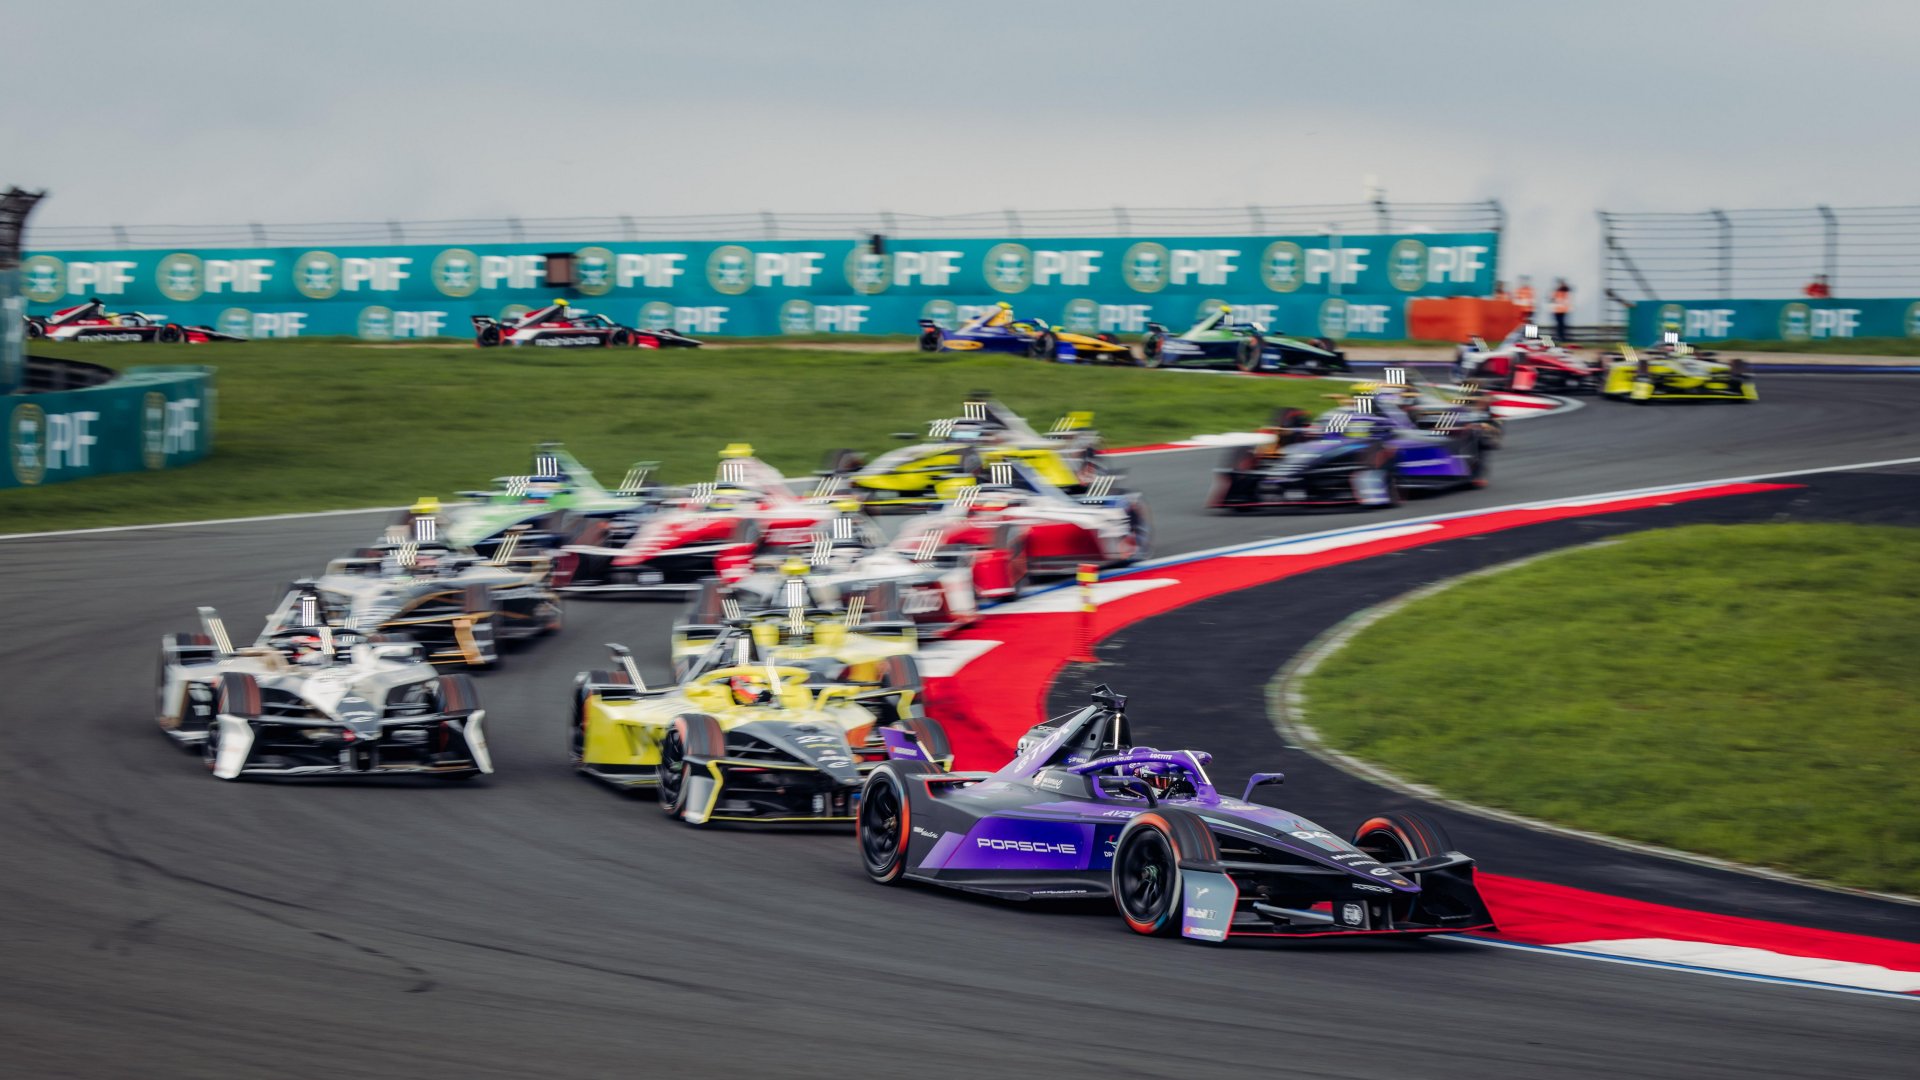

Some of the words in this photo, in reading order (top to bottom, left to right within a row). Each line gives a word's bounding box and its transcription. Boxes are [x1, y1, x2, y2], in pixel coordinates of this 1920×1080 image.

[67, 261, 137, 294] PIF
[205, 259, 275, 293] PIF
[342, 257, 412, 291] PIF
[481, 255, 547, 289] PIF
[617, 253, 687, 287] PIF
[755, 252, 825, 287] PIF
[894, 251, 963, 286] PIF
[1033, 250, 1103, 285] PIF
[1171, 249, 1240, 285] PIF
[1305, 247, 1370, 283] PIF
[1429, 246, 1488, 282] PIF
[253, 312, 307, 338] PIF
[394, 310, 447, 337] PIF
[675, 306, 728, 333] PIF
[815, 304, 868, 332] PIF
[1099, 304, 1152, 331] PIF
[1346, 304, 1391, 333] PIF
[1685, 308, 1736, 337] PIF
[1810, 308, 1862, 337] PIF
[46, 411, 100, 469] PIF
[1149, 753, 1173, 761] LOCTITE
[1103, 810, 1140, 818] AVEV
[977, 838, 1077, 855] PORSCHE
[1352, 883, 1393, 894] PORSCHE
